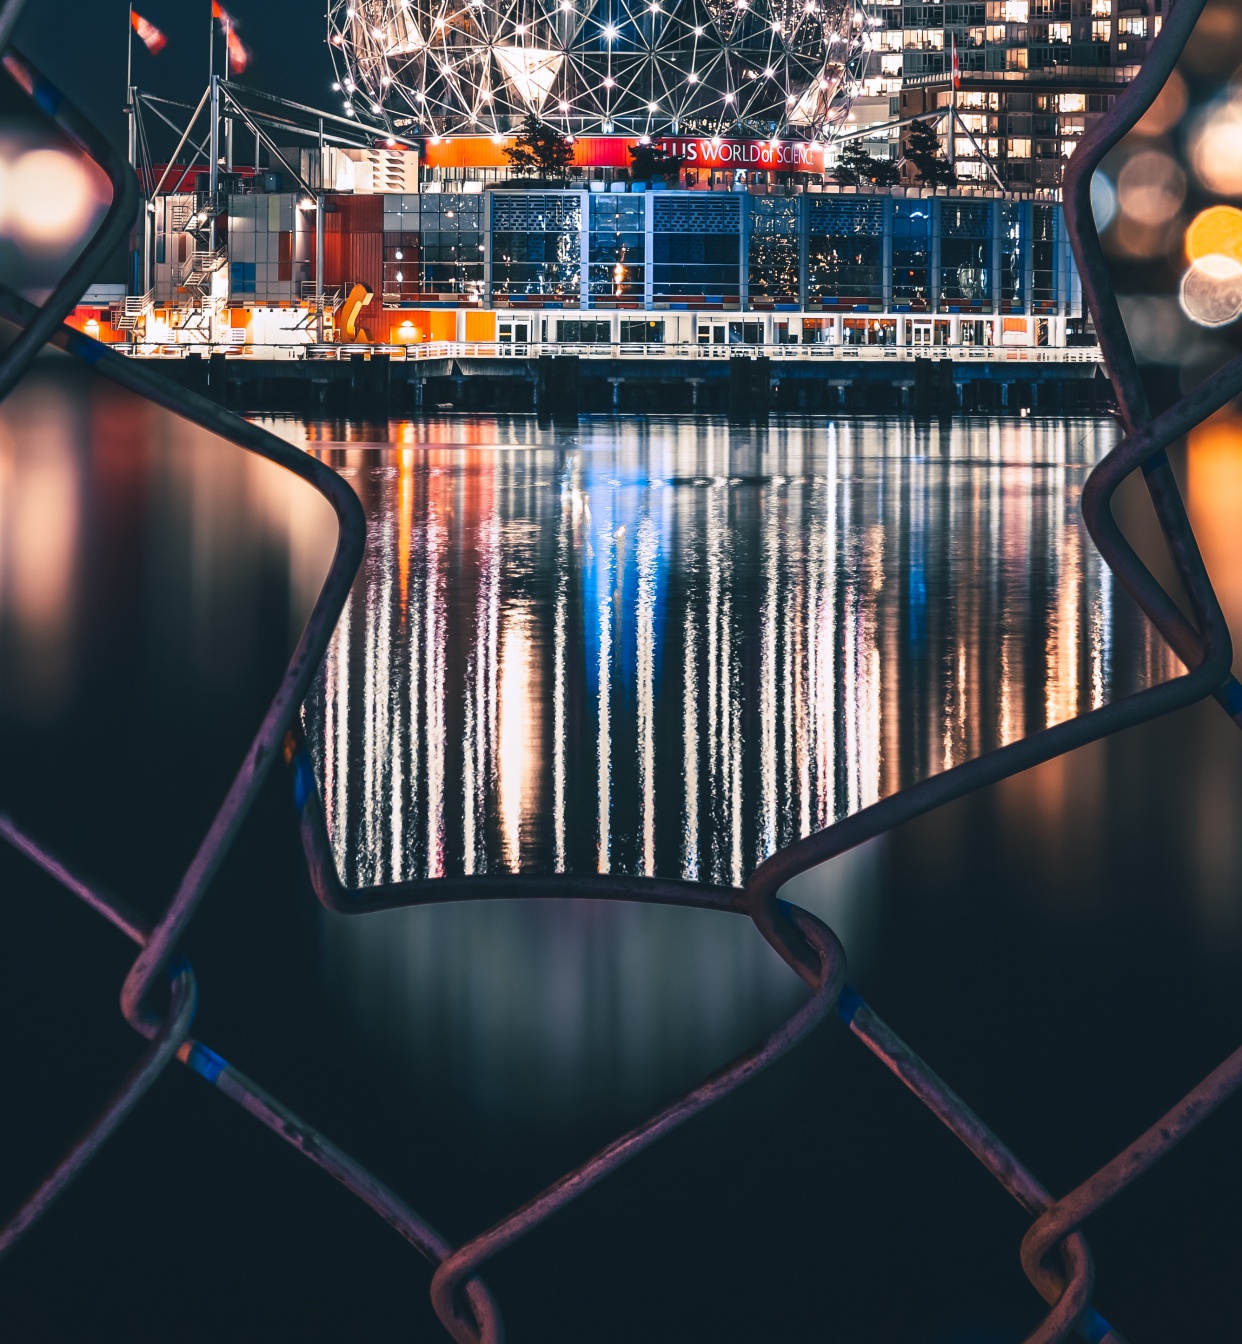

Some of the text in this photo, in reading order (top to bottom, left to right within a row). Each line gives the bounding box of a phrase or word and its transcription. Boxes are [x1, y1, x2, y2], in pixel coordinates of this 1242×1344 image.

[701, 143, 760, 162] WORLD
[761, 145, 774, 163] of
[777, 146, 814, 165] SCIENCE
